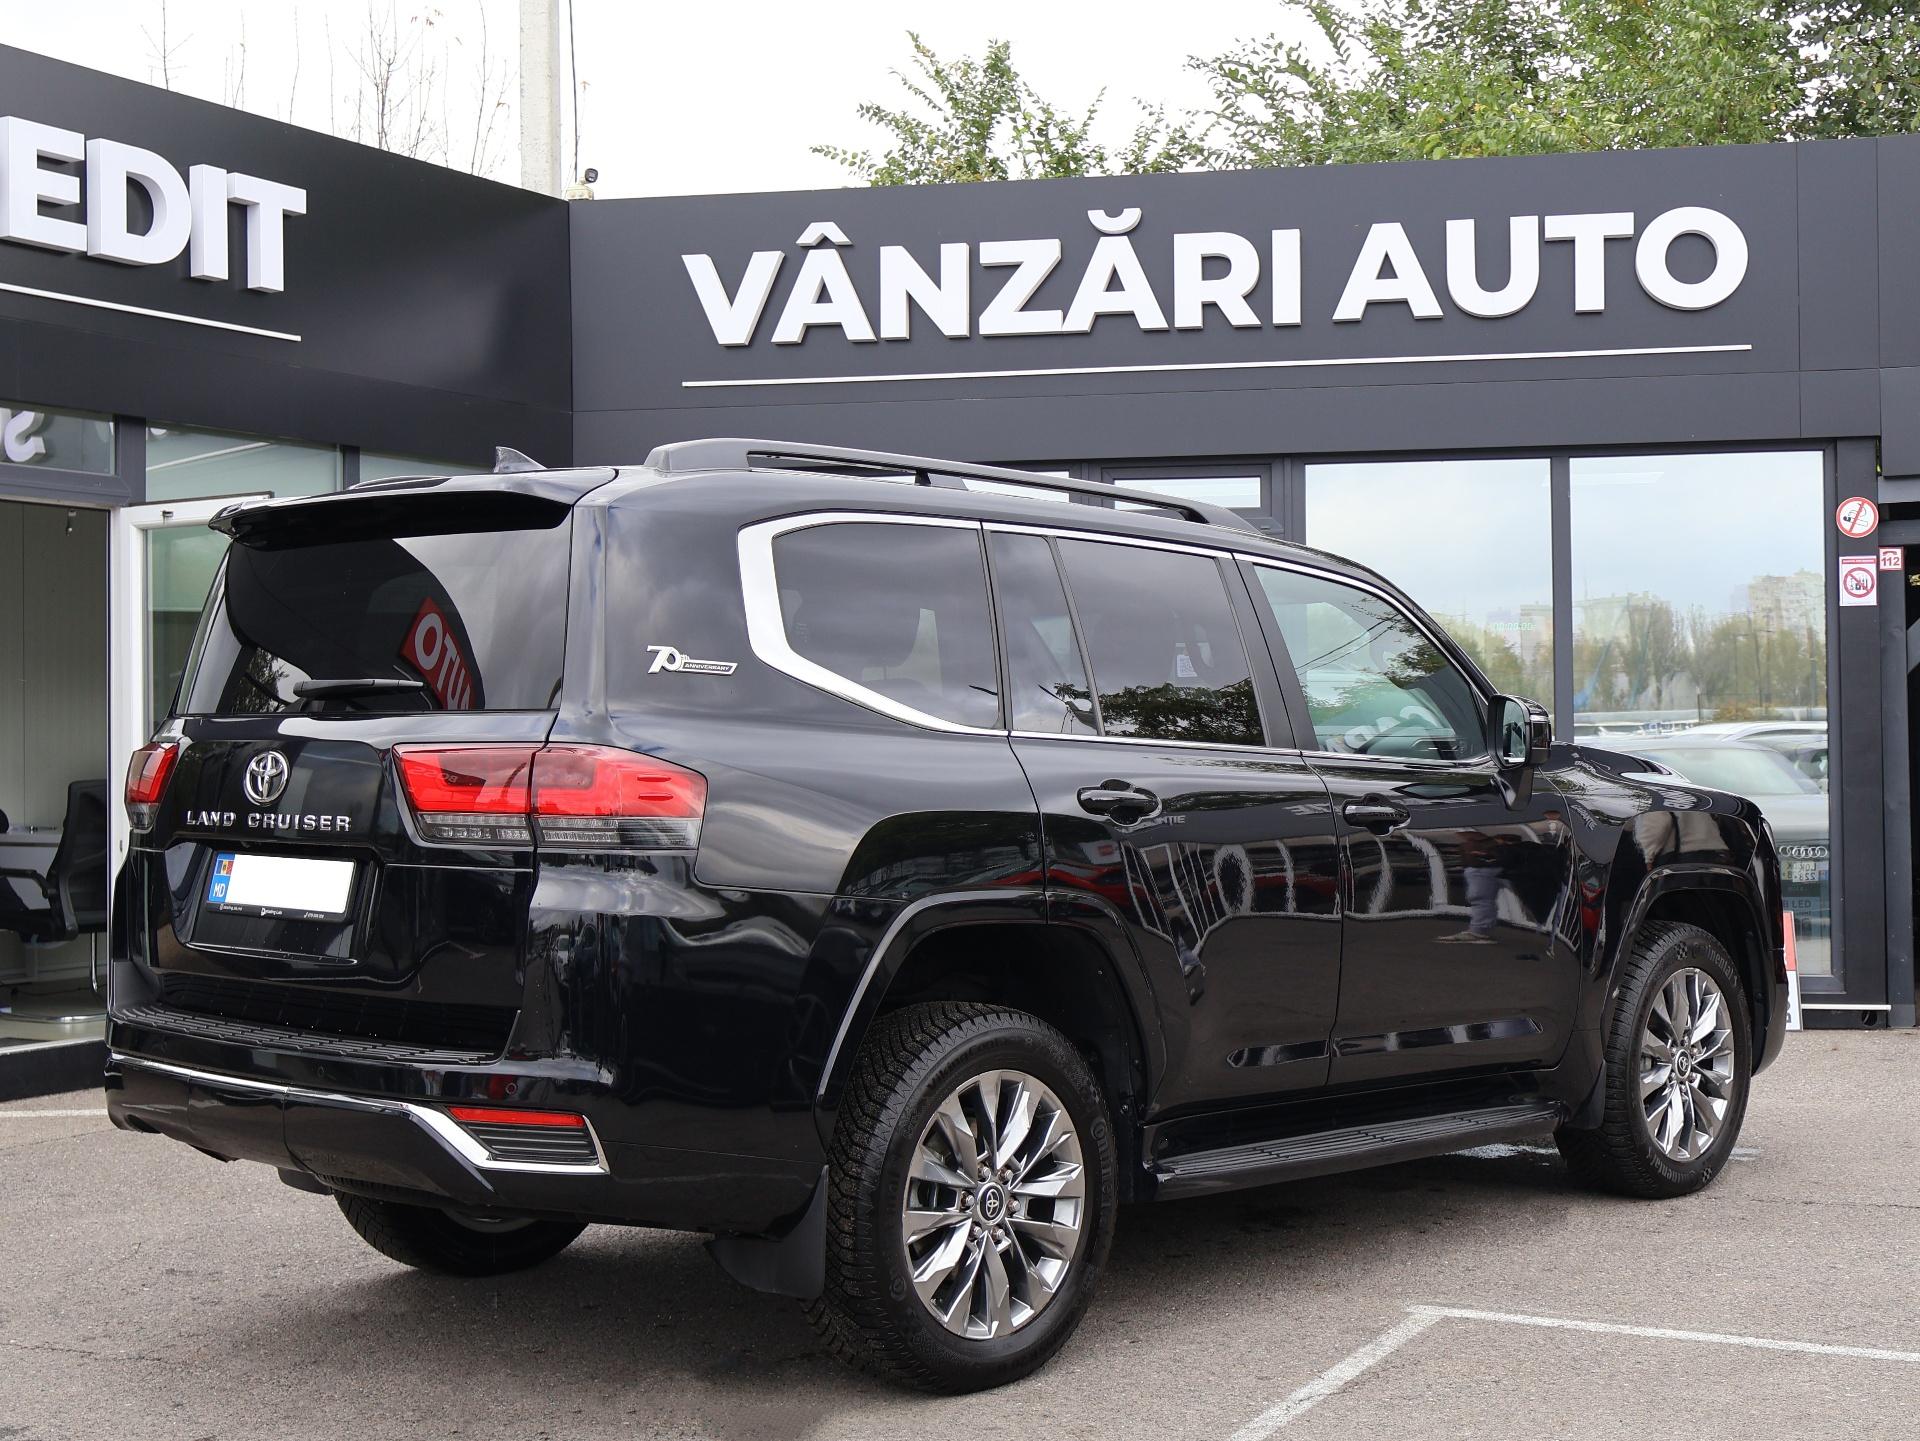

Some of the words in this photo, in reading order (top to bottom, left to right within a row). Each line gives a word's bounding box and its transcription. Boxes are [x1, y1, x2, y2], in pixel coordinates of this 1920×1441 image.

[681, 207, 1301, 347] VÂNZĂRI
[1332, 205, 1749, 324] AUTO
[1881, 556, 1900, 567] 112
[186, 810, 236, 826] LAND
[248, 812, 351, 832] CRUISER
[212, 882, 226, 898] MD
